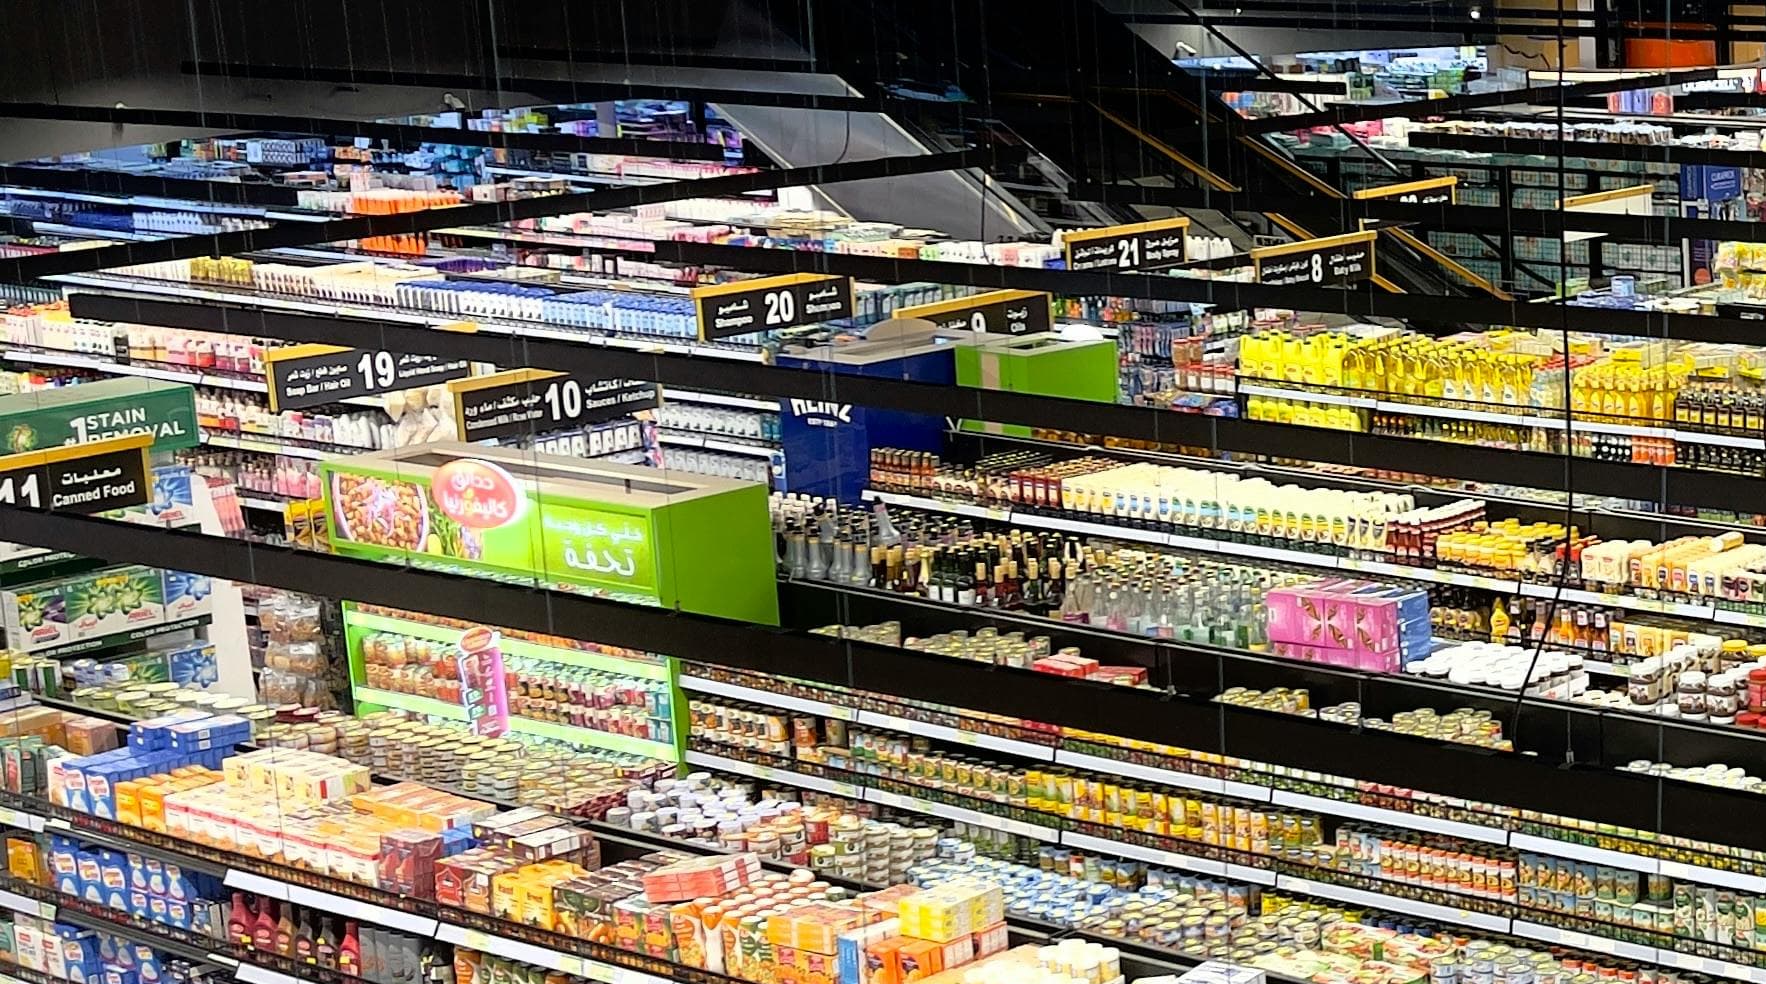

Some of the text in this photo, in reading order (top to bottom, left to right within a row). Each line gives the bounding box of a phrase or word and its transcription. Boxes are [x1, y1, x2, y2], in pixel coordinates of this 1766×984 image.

[1118, 238, 1139, 268] 21
[1311, 253, 1323, 283] 8
[764, 290, 795, 325] 20
[971, 311, 987, 333] 9
[357, 351, 396, 390] 19
[545, 380, 582, 421] 10
[586, 396, 616, 410] Sauces
[621, 390, 655, 404] Ketchup
[87, 408, 146, 430] STAIN
[61, 467, 121, 486] معلبات
[53, 481, 135, 507] Canned Food
